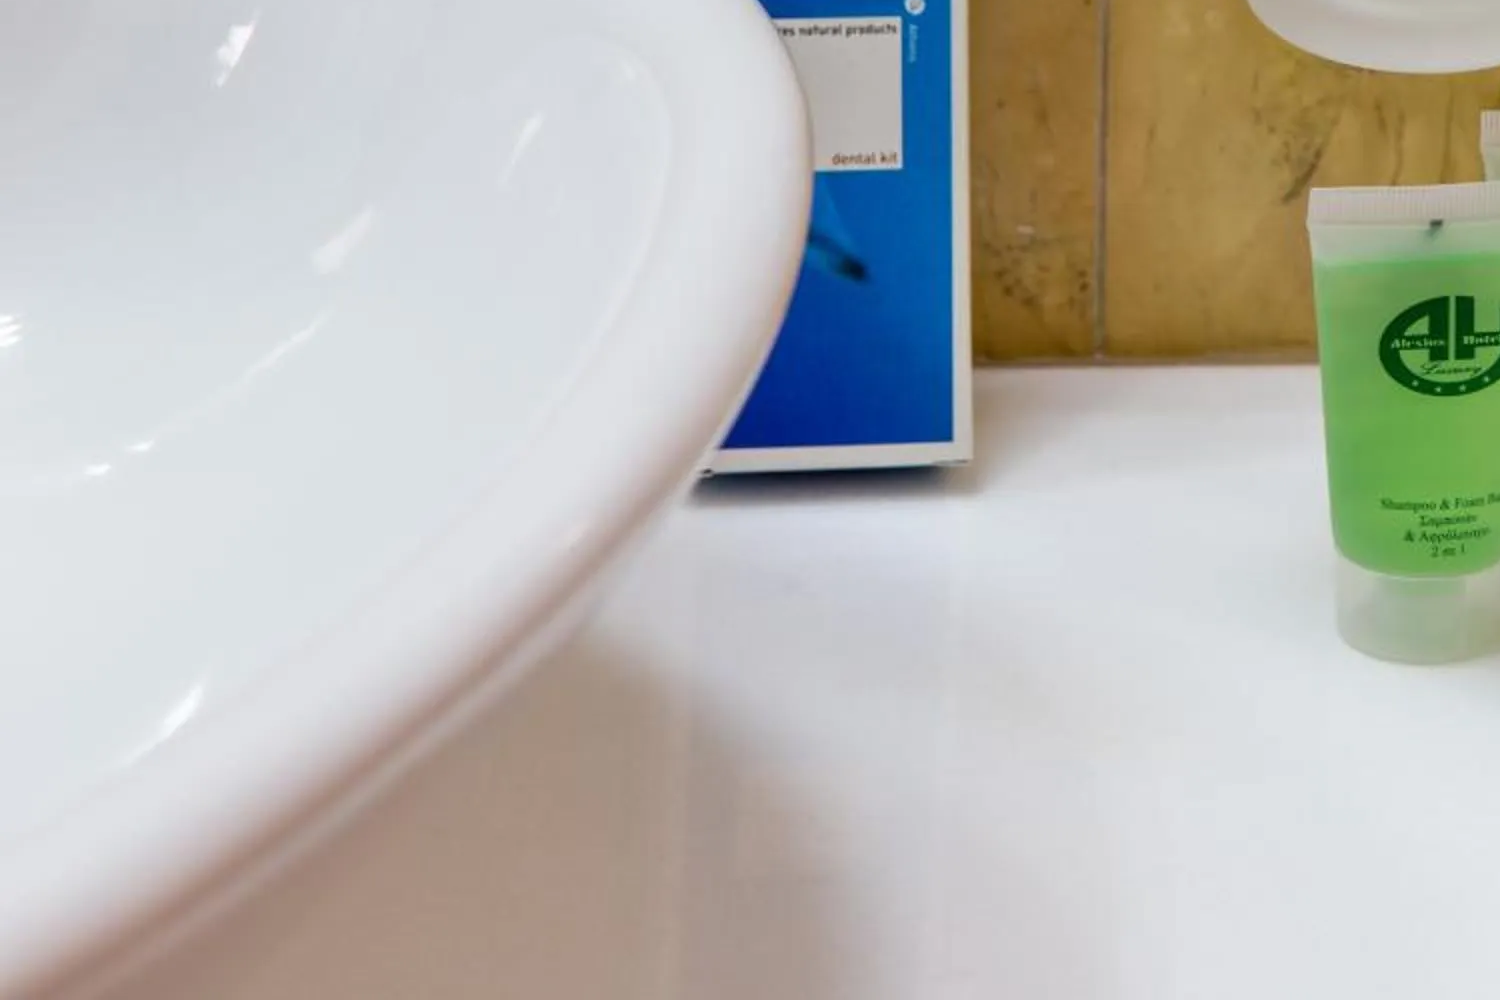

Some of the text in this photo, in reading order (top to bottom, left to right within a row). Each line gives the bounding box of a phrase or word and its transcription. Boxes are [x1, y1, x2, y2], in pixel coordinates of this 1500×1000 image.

[798, 23, 842, 36] natural
[845, 23, 898, 39] products
[831, 152, 898, 166] dental kit
[1380, 497, 1437, 514] Shampoo
[1439, 499, 1450, 511] &
[1455, 497, 1486, 511] Foam
[1404, 529, 1415, 542] &
[1431, 545, 1438, 558] 2
